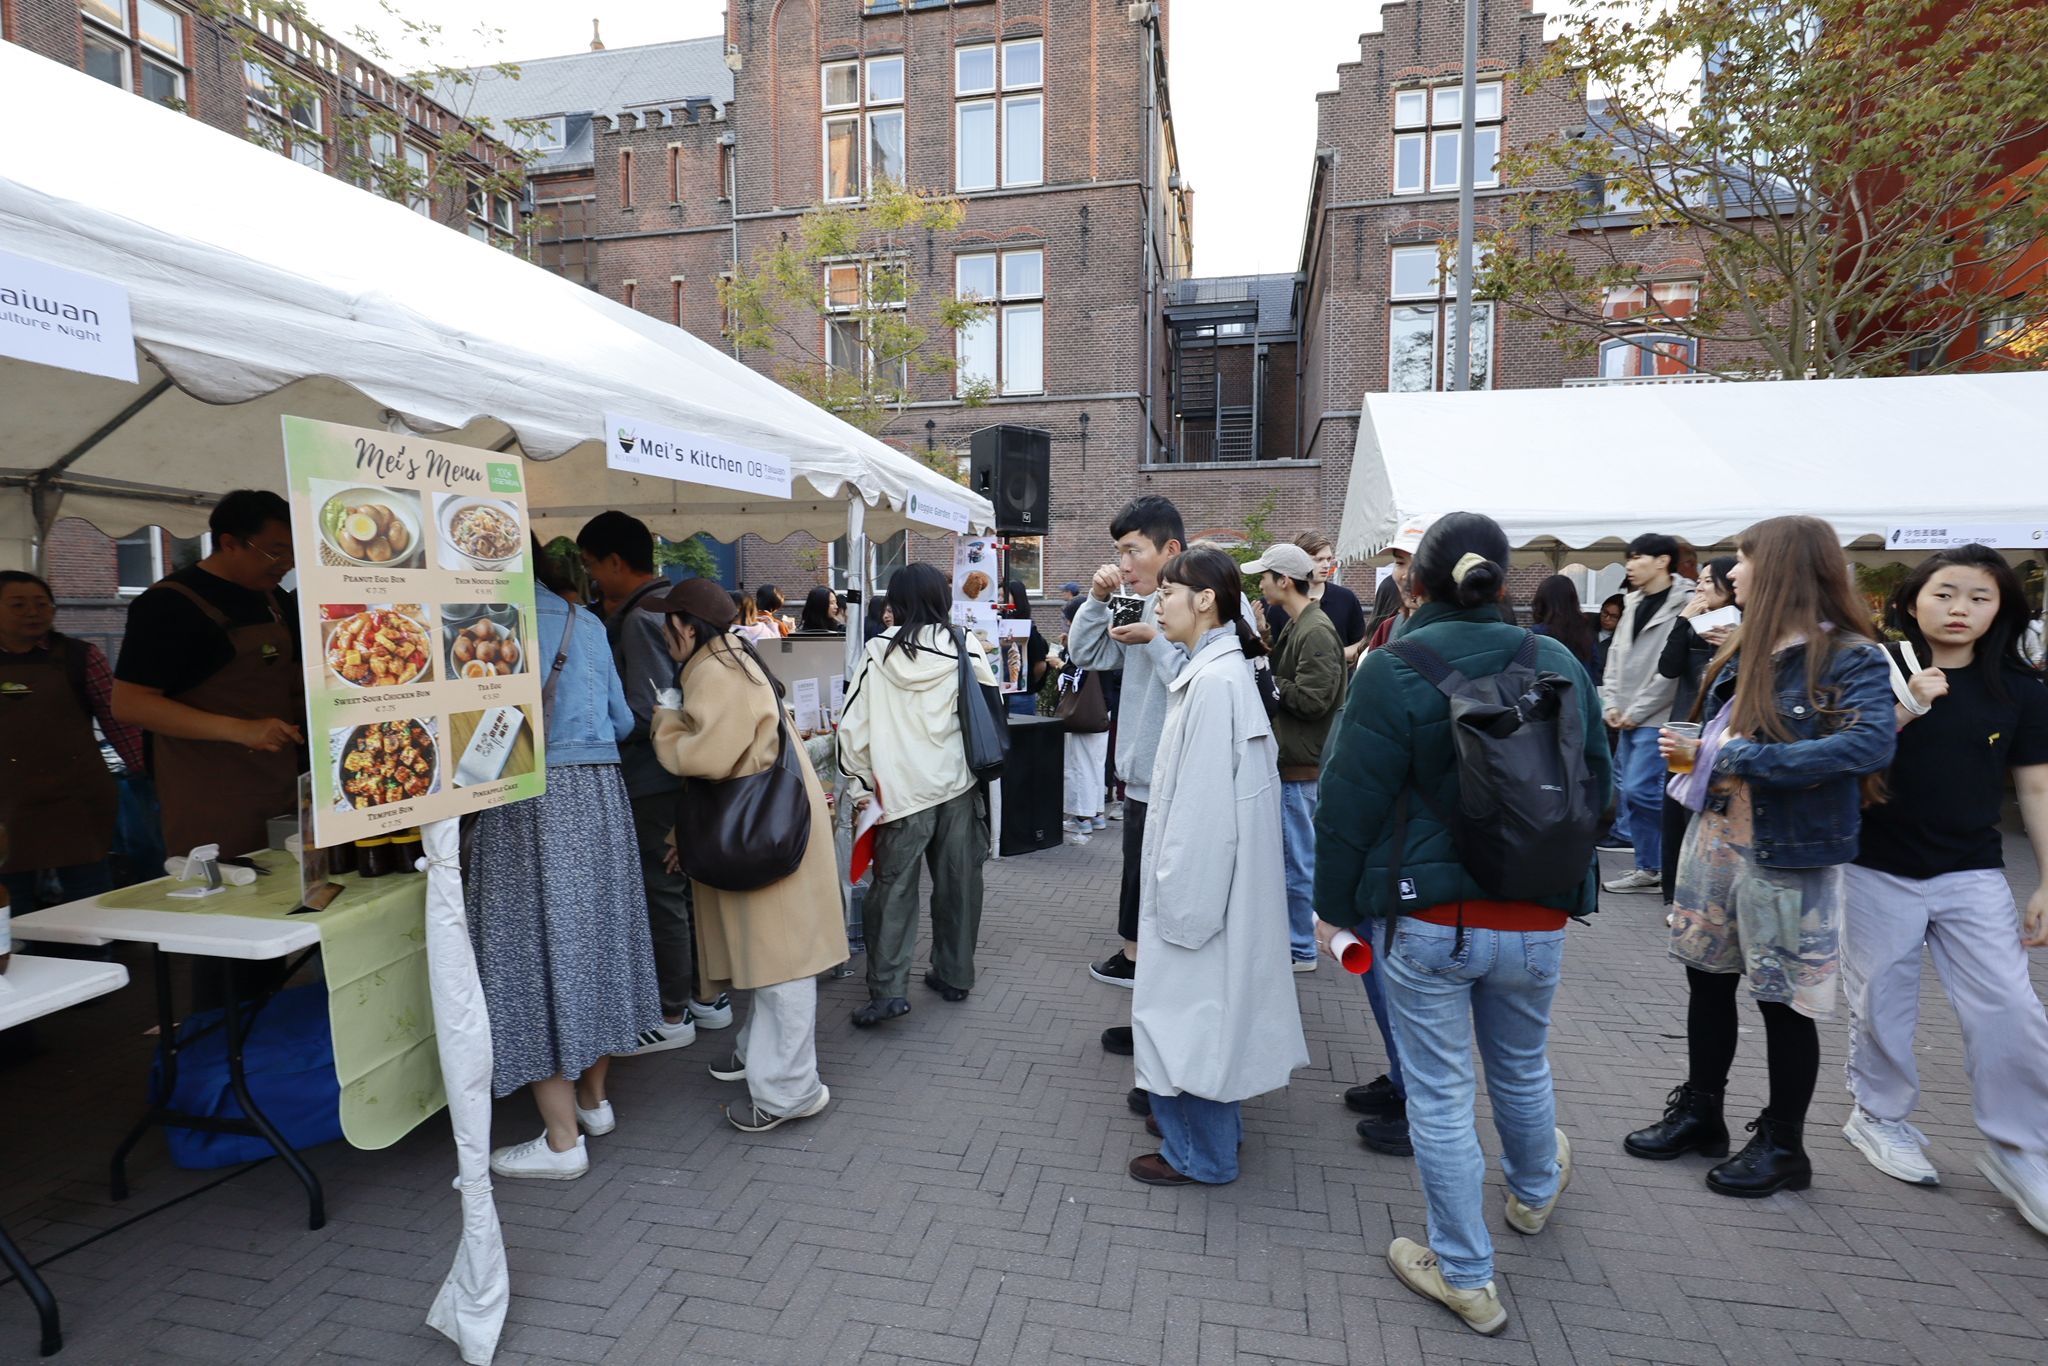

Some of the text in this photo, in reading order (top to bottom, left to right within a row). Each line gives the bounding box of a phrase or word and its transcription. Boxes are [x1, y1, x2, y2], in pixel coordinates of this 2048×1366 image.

[0, 287, 100, 326] aiwan
[0, 311, 102, 343] ulture Night
[354, 437, 484, 488] Mei's Menu
[640, 438, 684, 462] Mei's
[690, 449, 743, 474] Kitchen
[747, 460, 763, 478] 08
[1930, 537, 1949, 545] Bag
[374, 575, 390, 583] EGG
[390, 575, 407, 583] BUN
[334, 690, 431, 706] SWEET SOUR CHICKEN BUN
